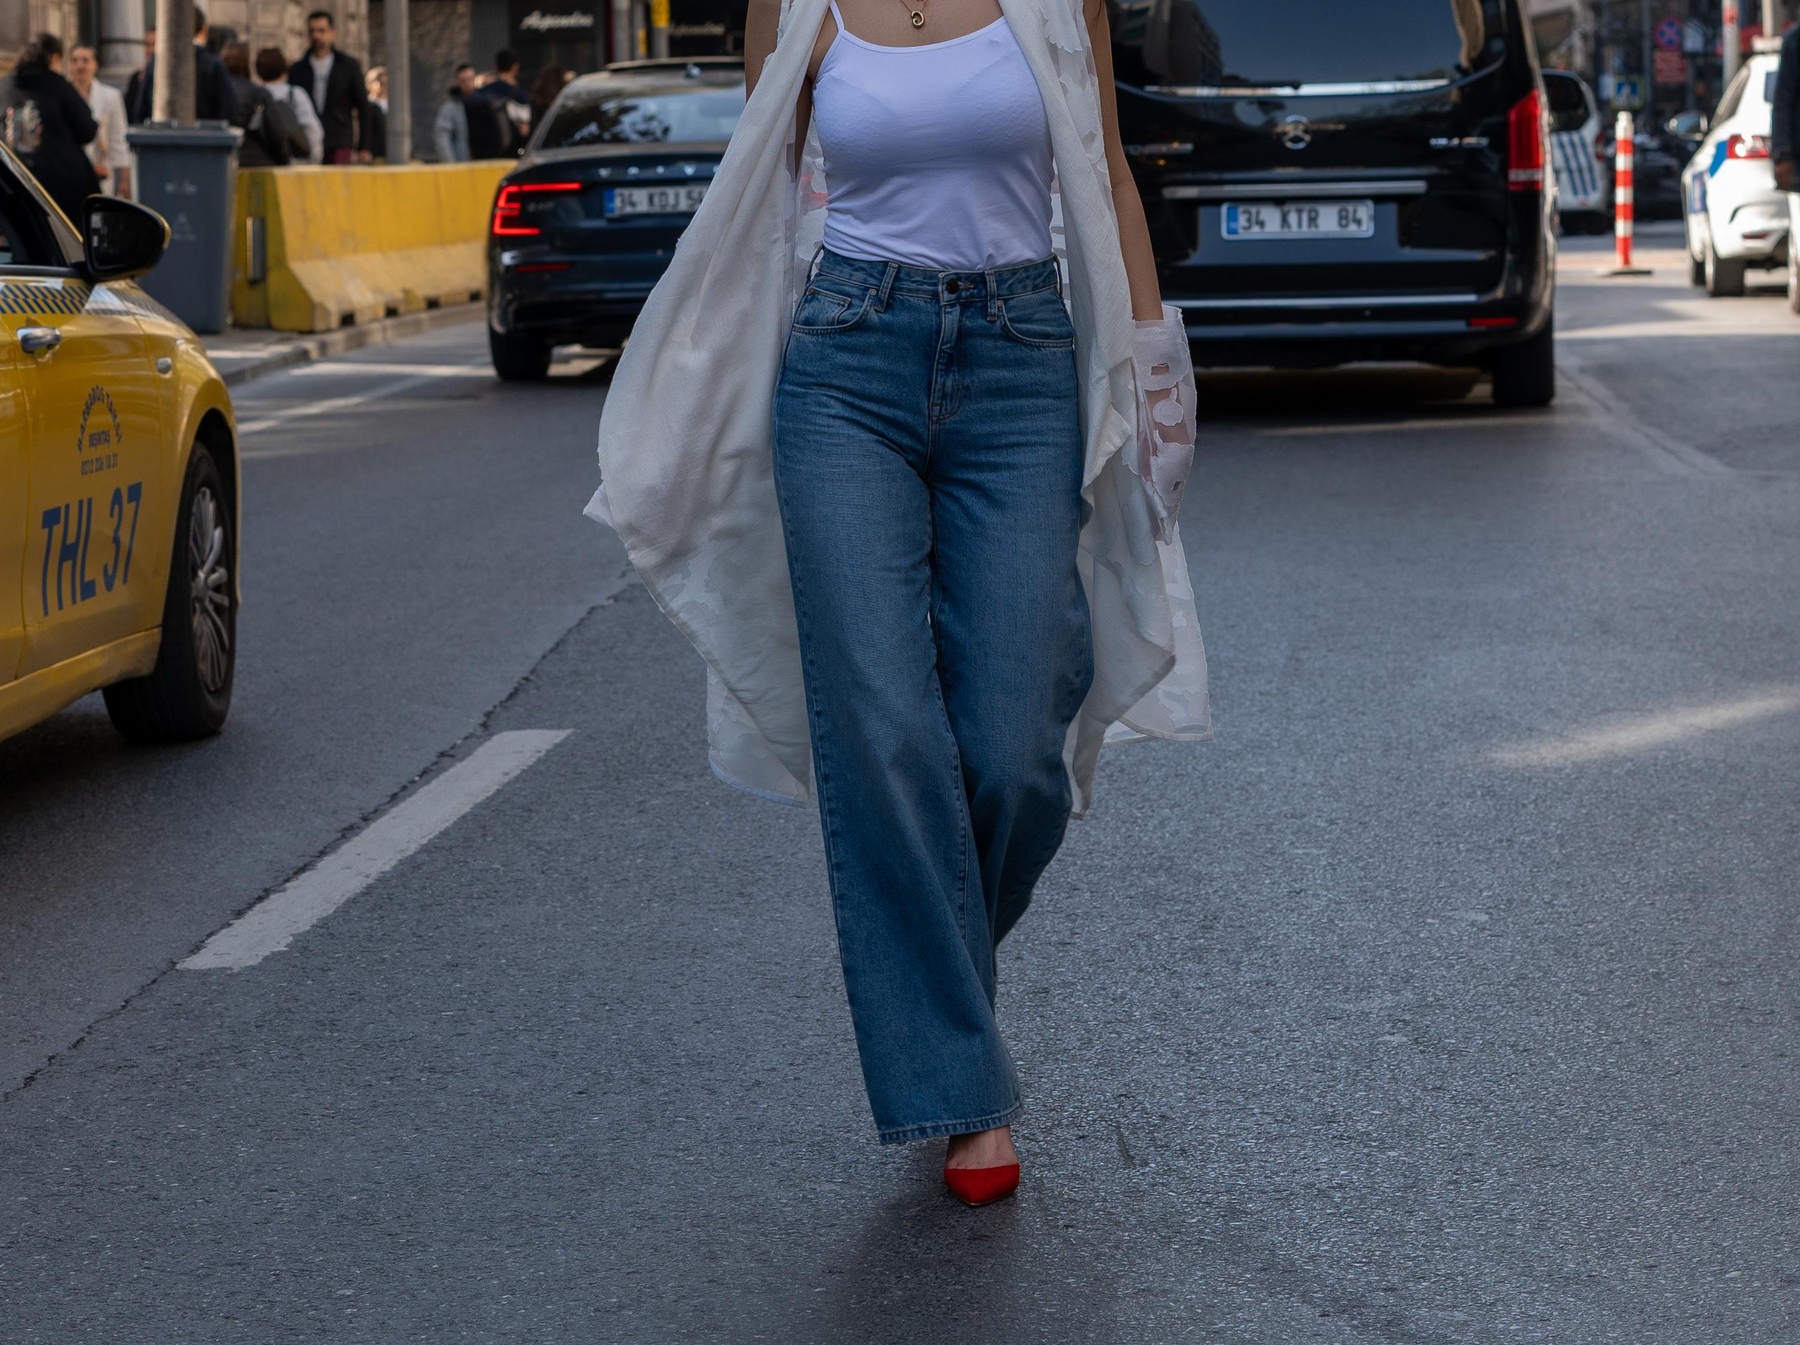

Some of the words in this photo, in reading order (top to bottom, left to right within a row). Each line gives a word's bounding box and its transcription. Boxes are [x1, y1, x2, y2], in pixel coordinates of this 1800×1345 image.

[1241, 208, 1265, 231] 34
[1280, 207, 1320, 230] KTR
[1337, 207, 1362, 229] 84
[41, 497, 96, 617] THL
[103, 481, 143, 593] 37
